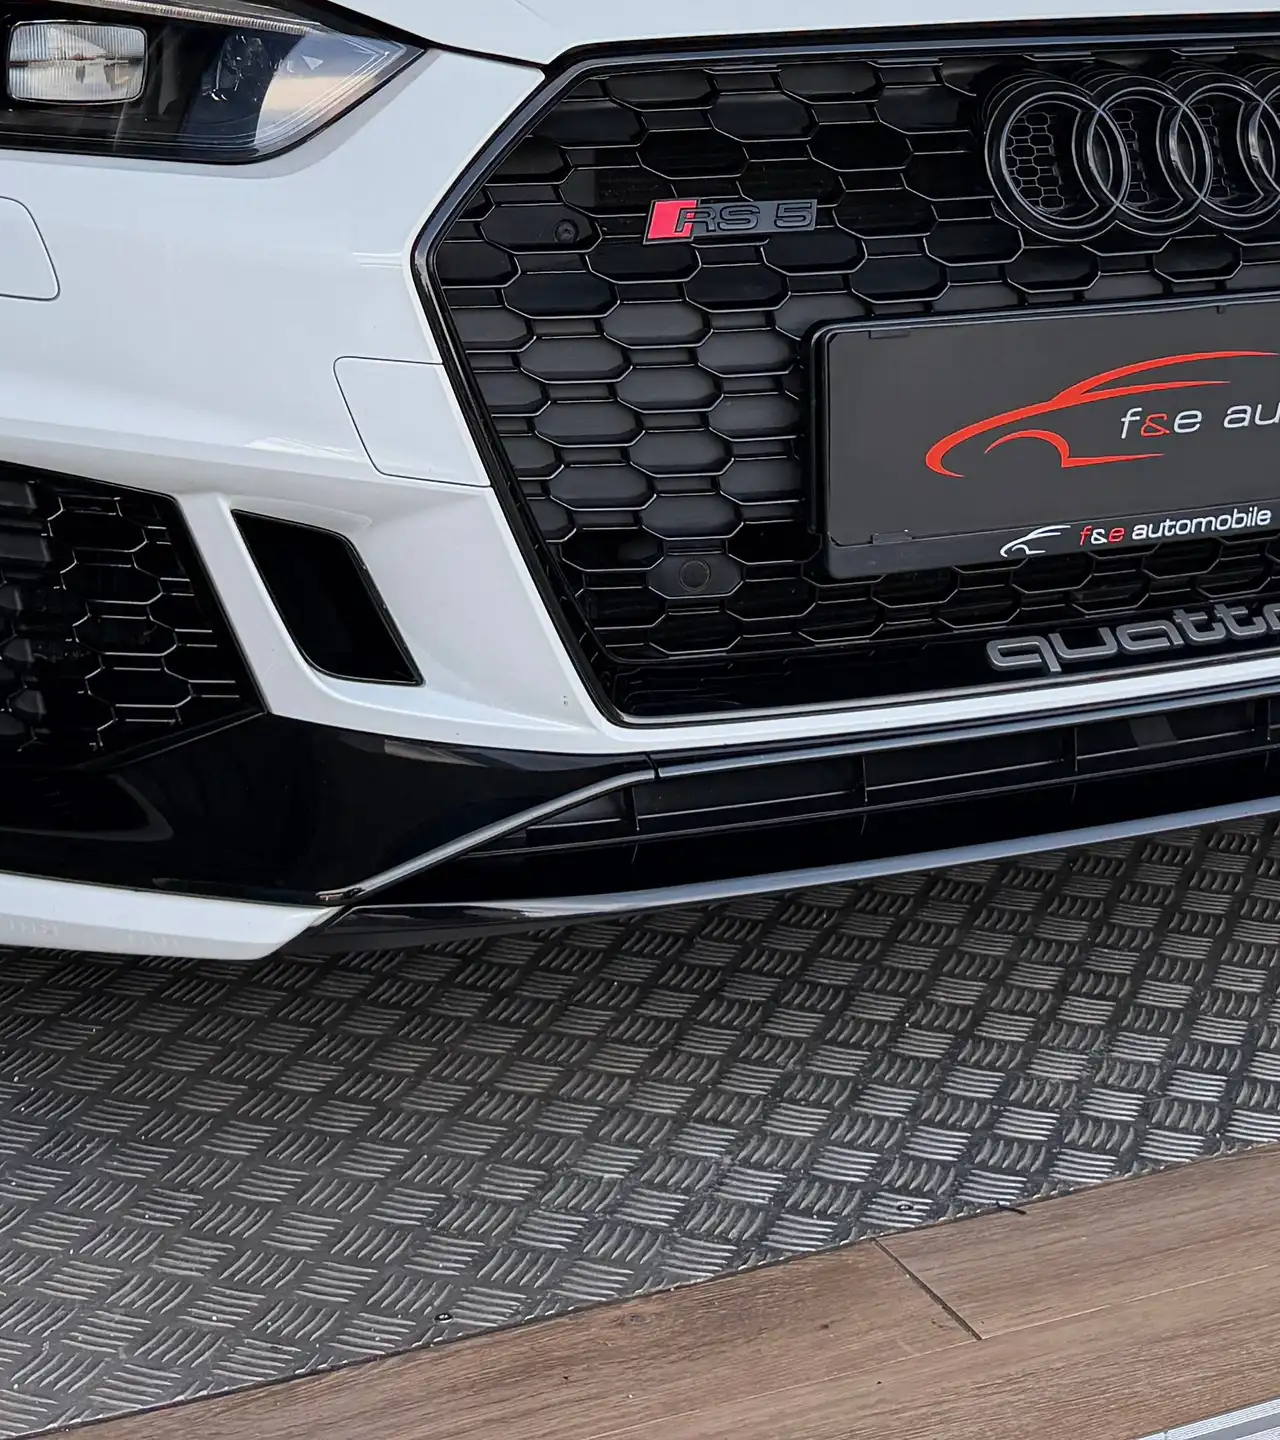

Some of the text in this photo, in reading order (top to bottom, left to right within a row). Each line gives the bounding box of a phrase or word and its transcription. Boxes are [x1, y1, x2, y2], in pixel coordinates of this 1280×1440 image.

[673, 201, 813, 234] RS 5
[1120, 407, 1202, 439] f&e
[1079, 506, 1272, 546] f&e automobile
